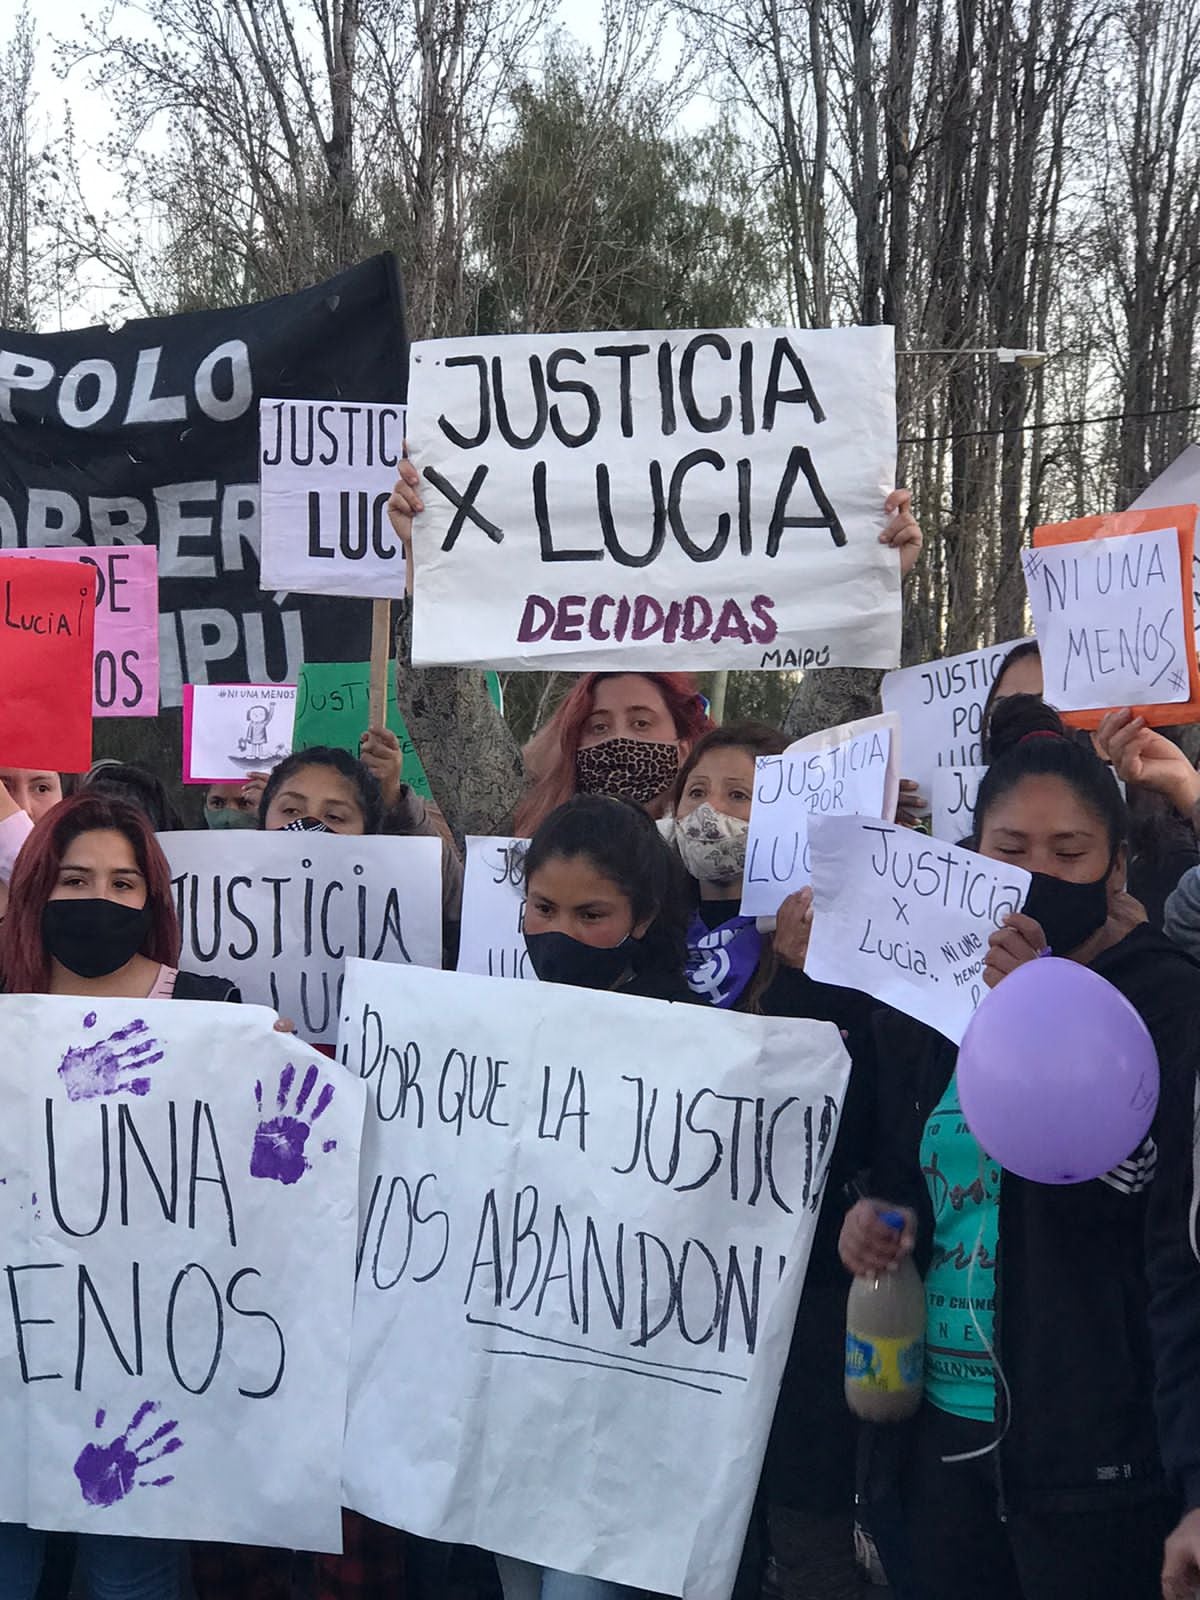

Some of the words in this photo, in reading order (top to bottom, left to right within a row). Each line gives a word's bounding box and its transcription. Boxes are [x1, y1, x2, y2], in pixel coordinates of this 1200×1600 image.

[438, 333, 828, 450] JUSTICIA
[308, 491, 406, 560] LUC
[423, 463, 504, 551] X
[532, 445, 848, 568] LUCIA
[1096, 543, 1166, 596] UNA
[517, 594, 779, 645] DECIDIDAS
[760, 645, 831, 668] MAIPÚ
[240, 690, 258, 699] UNA
[261, 690, 296, 699] MENOS
[438, 1047, 510, 1137] QUE
[538, 1065, 591, 1152] LA
[45, 1097, 237, 1247] UNA
[3, 1261, 286, 1400] ENOS
